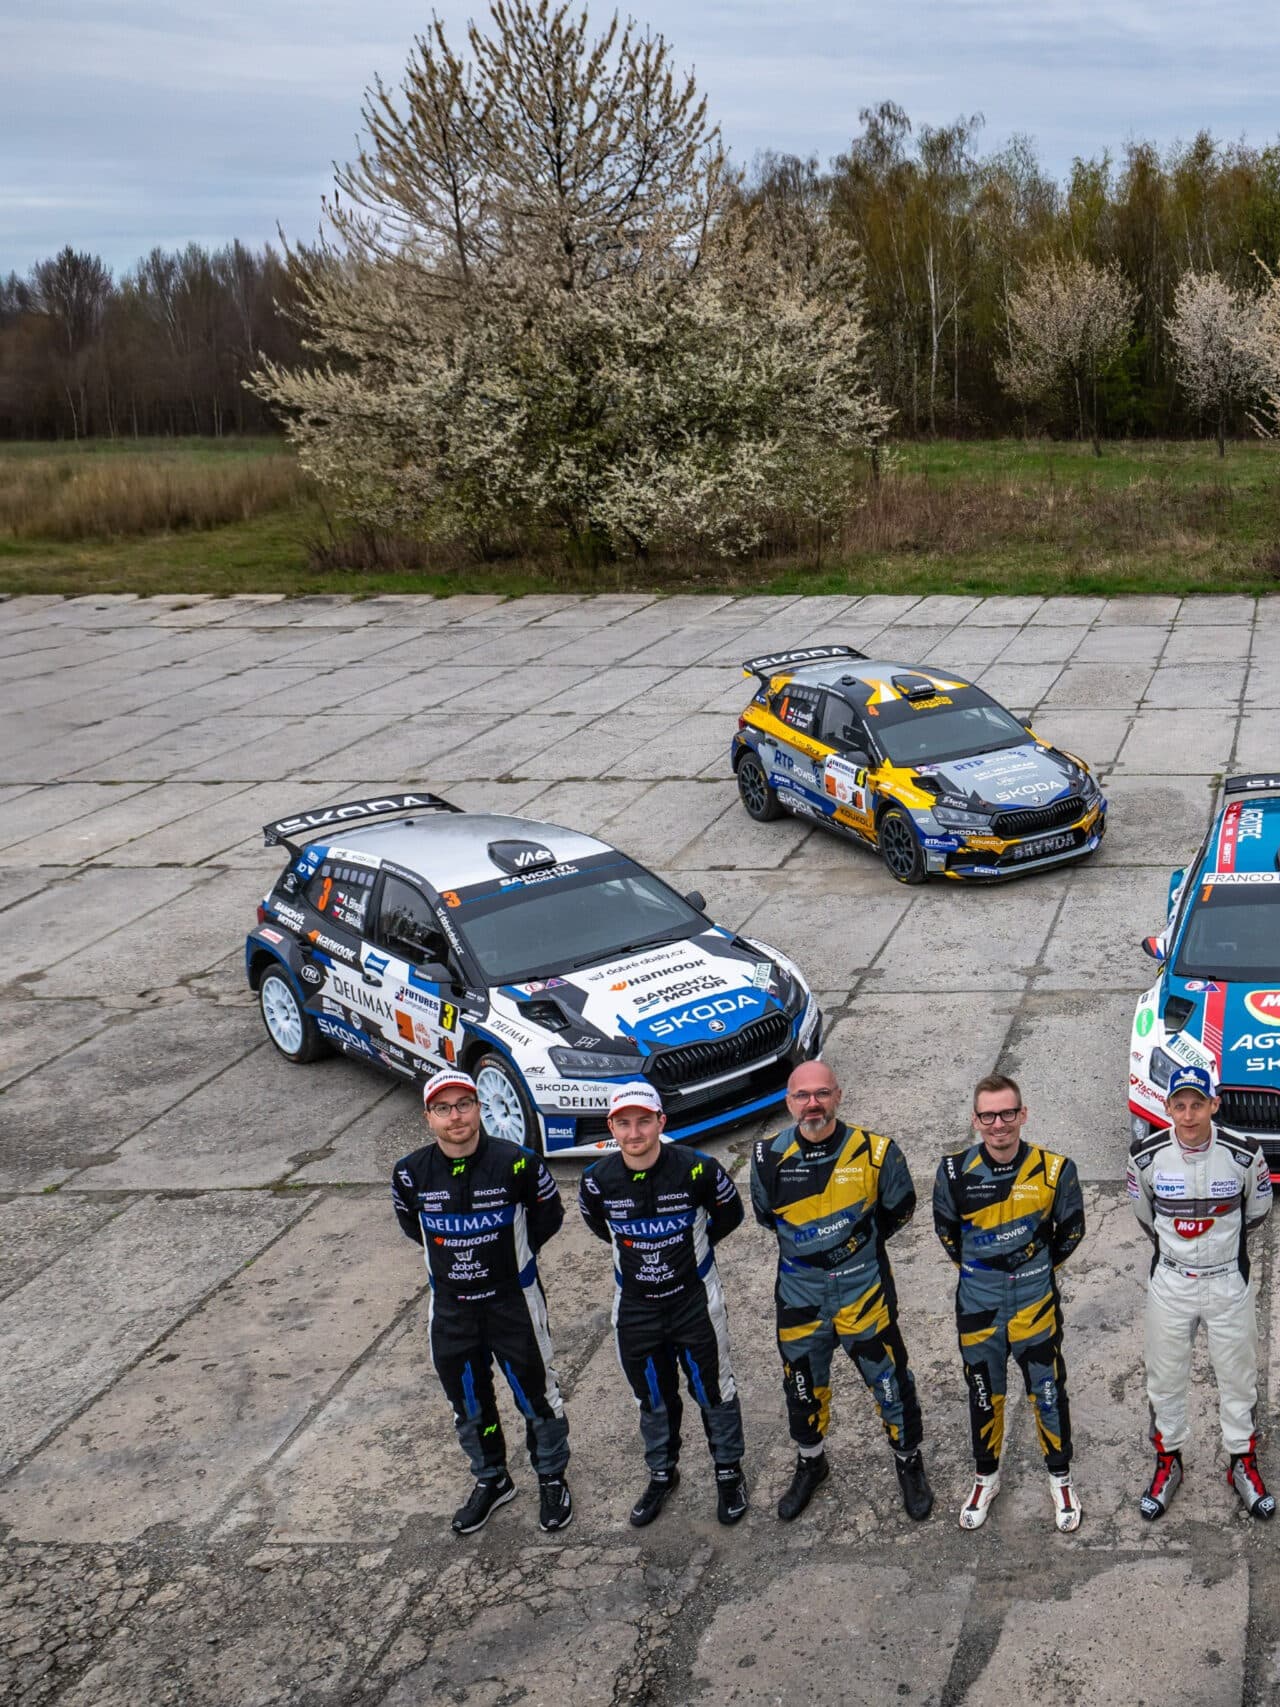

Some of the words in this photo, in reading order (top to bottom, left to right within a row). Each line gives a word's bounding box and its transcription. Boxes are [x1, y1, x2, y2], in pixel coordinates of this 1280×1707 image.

[774, 749, 794, 770] RTP
[1205, 874, 1274, 883] FRANCO
[318, 877, 333, 911] 3
[442, 891, 461, 908] 3
[1202, 885, 1214, 902] 1
[632, 973, 721, 1005] SAMOHÝL
[663, 978, 728, 1003] MOTOR
[333, 976, 395, 1021] DELIMAX
[405, 989, 439, 1011] FUTURES
[443, 1003, 454, 1030] 3
[490, 1020, 532, 1047] DELIMAX
[582, 1083, 608, 1092] Online
[559, 1096, 610, 1108] DELIM
[426, 1212, 504, 1234] DELIMAX
[613, 1217, 688, 1235] DELIMAX
[818, 1218, 850, 1236] POWER
[1177, 1221, 1203, 1232] MOL
[996, 1225, 1028, 1241] POWER
[452, 1261, 482, 1271] dobré
[640, 1262, 669, 1274] dobré
